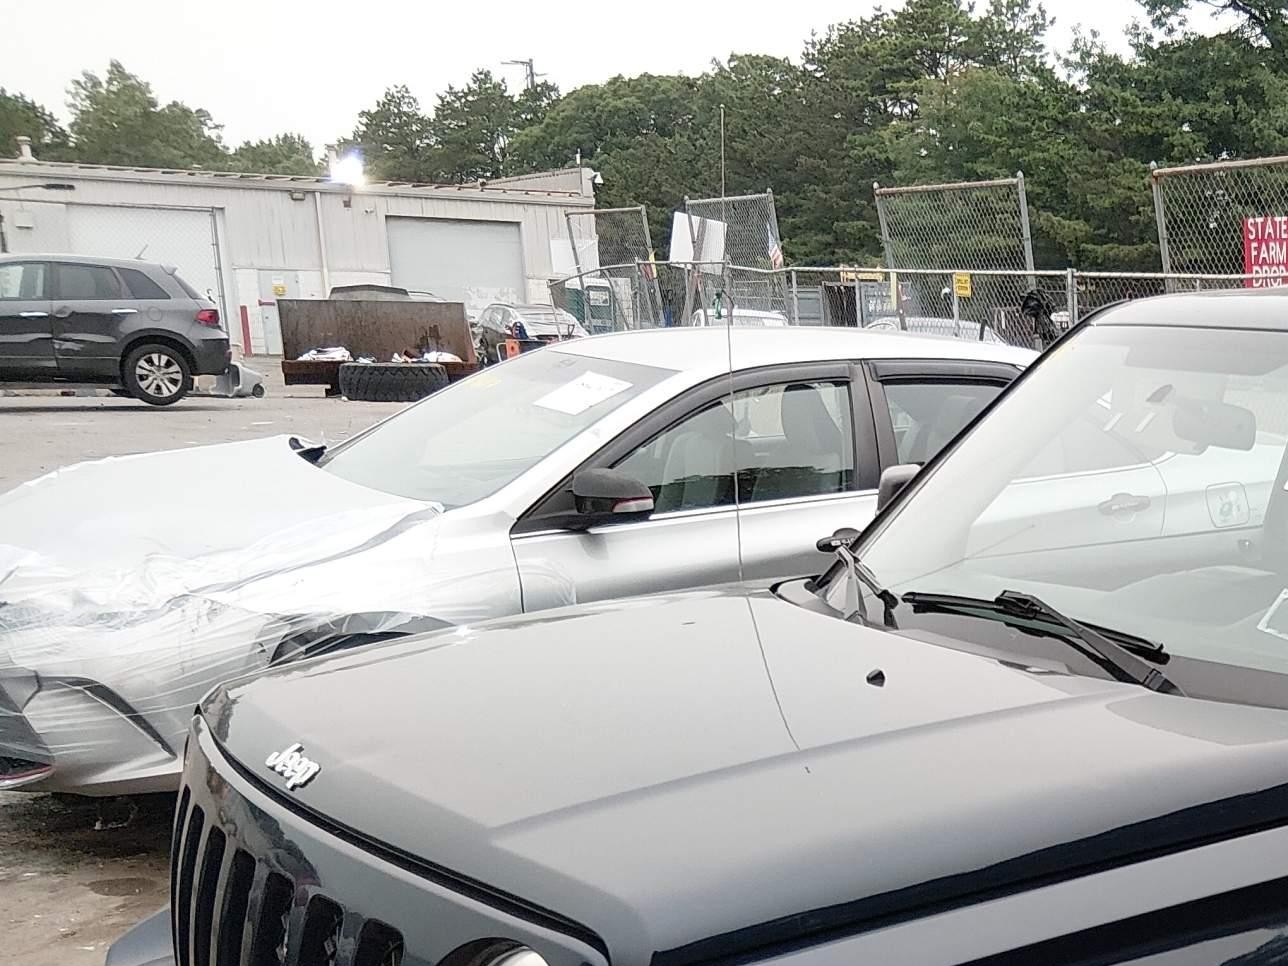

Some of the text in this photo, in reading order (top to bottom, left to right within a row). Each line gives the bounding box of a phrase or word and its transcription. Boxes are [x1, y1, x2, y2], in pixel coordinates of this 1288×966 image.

[1247, 217, 1288, 240] STATE
[1251, 242, 1287, 264] FARM
[1252, 265, 1287, 288] DROP
[264, 742, 321, 790] Jeep
